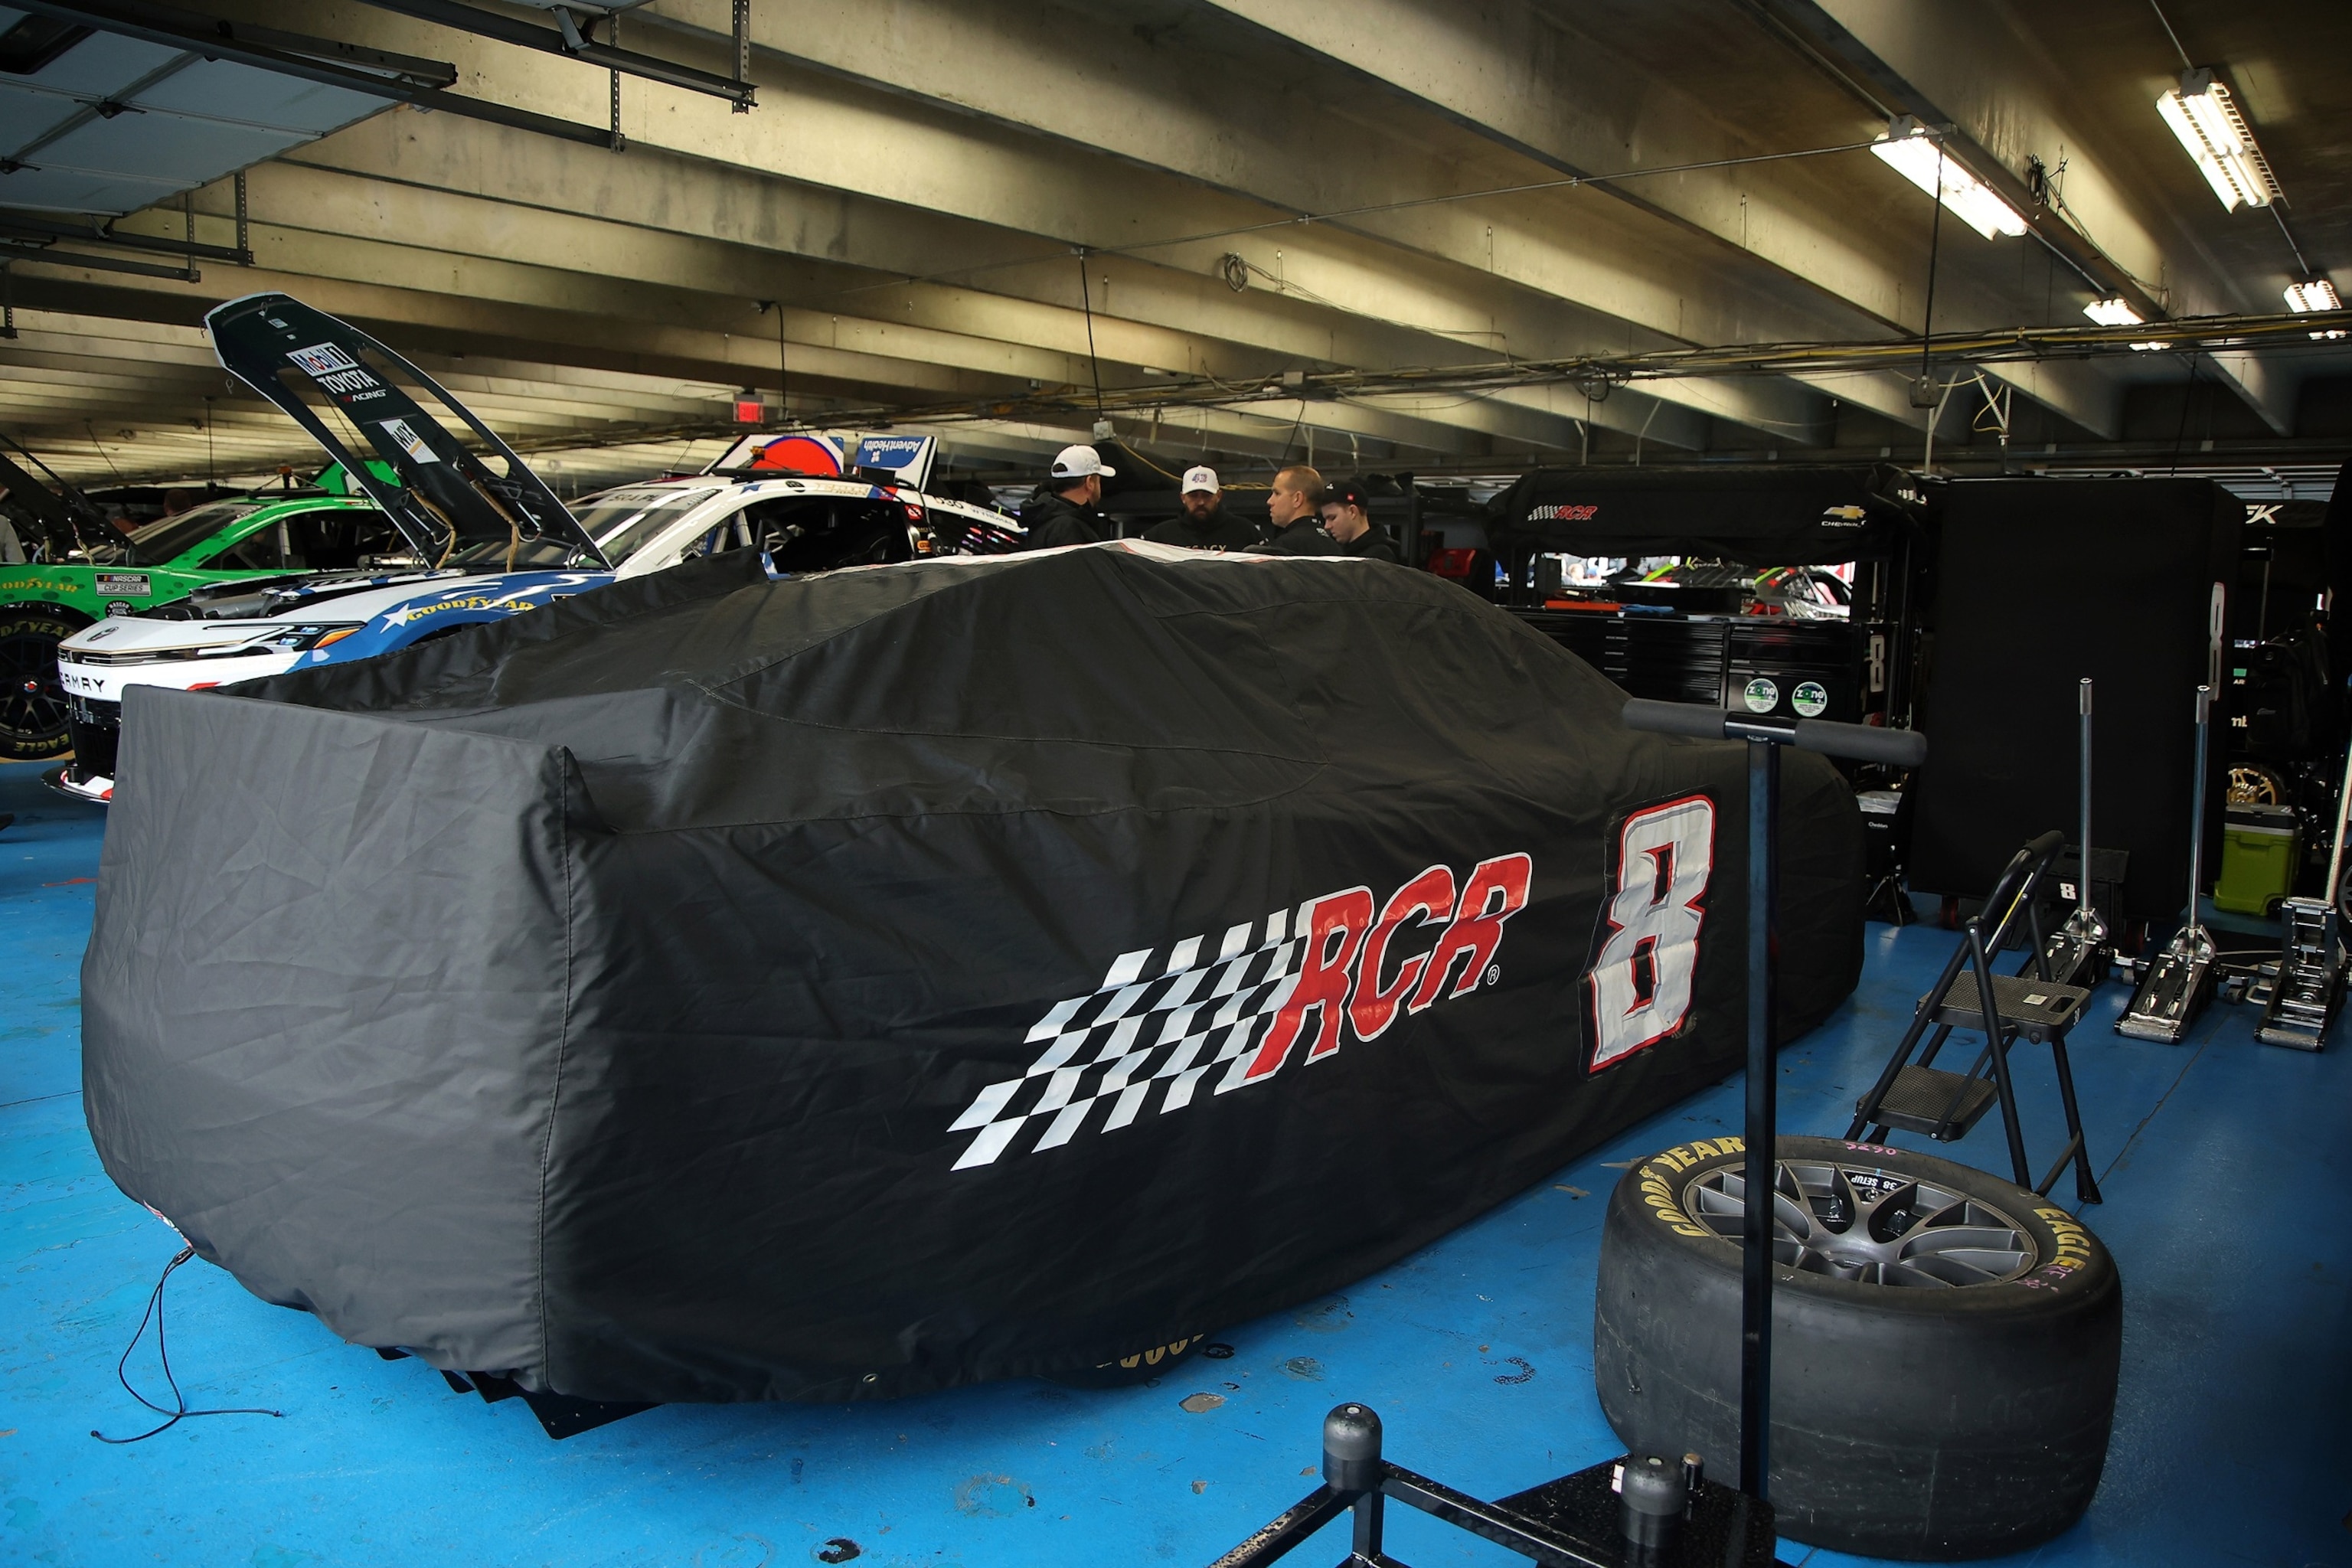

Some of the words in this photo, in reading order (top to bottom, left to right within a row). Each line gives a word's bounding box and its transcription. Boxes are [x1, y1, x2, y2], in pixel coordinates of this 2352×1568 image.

[292, 348, 341, 374] Mobil
[316, 369, 380, 394] TOYOTA
[339, 389, 387, 403] RACING
[391, 423, 418, 449] WIX
[864, 440, 921, 452] AdventHealth
[1192, 473, 1207, 483] 43
[1553, 505, 1598, 520] RCR
[407, 596, 536, 621] GOODYEAR
[1870, 635, 1885, 692] 8
[60, 671, 105, 692] CAMRY
[1749, 685, 1775, 695] zone
[1796, 688, 1824, 699] zone
[14, 733, 70, 753] EAGLE
[2060, 883, 2076, 900] 8
[1589, 794, 1716, 1073] 8
[1244, 851, 1532, 1081] RCR
[1850, 1174, 1879, 1187] SETUP
[1883, 1181, 1898, 1191] 38
[2033, 1208, 2091, 1270] EAGLE
